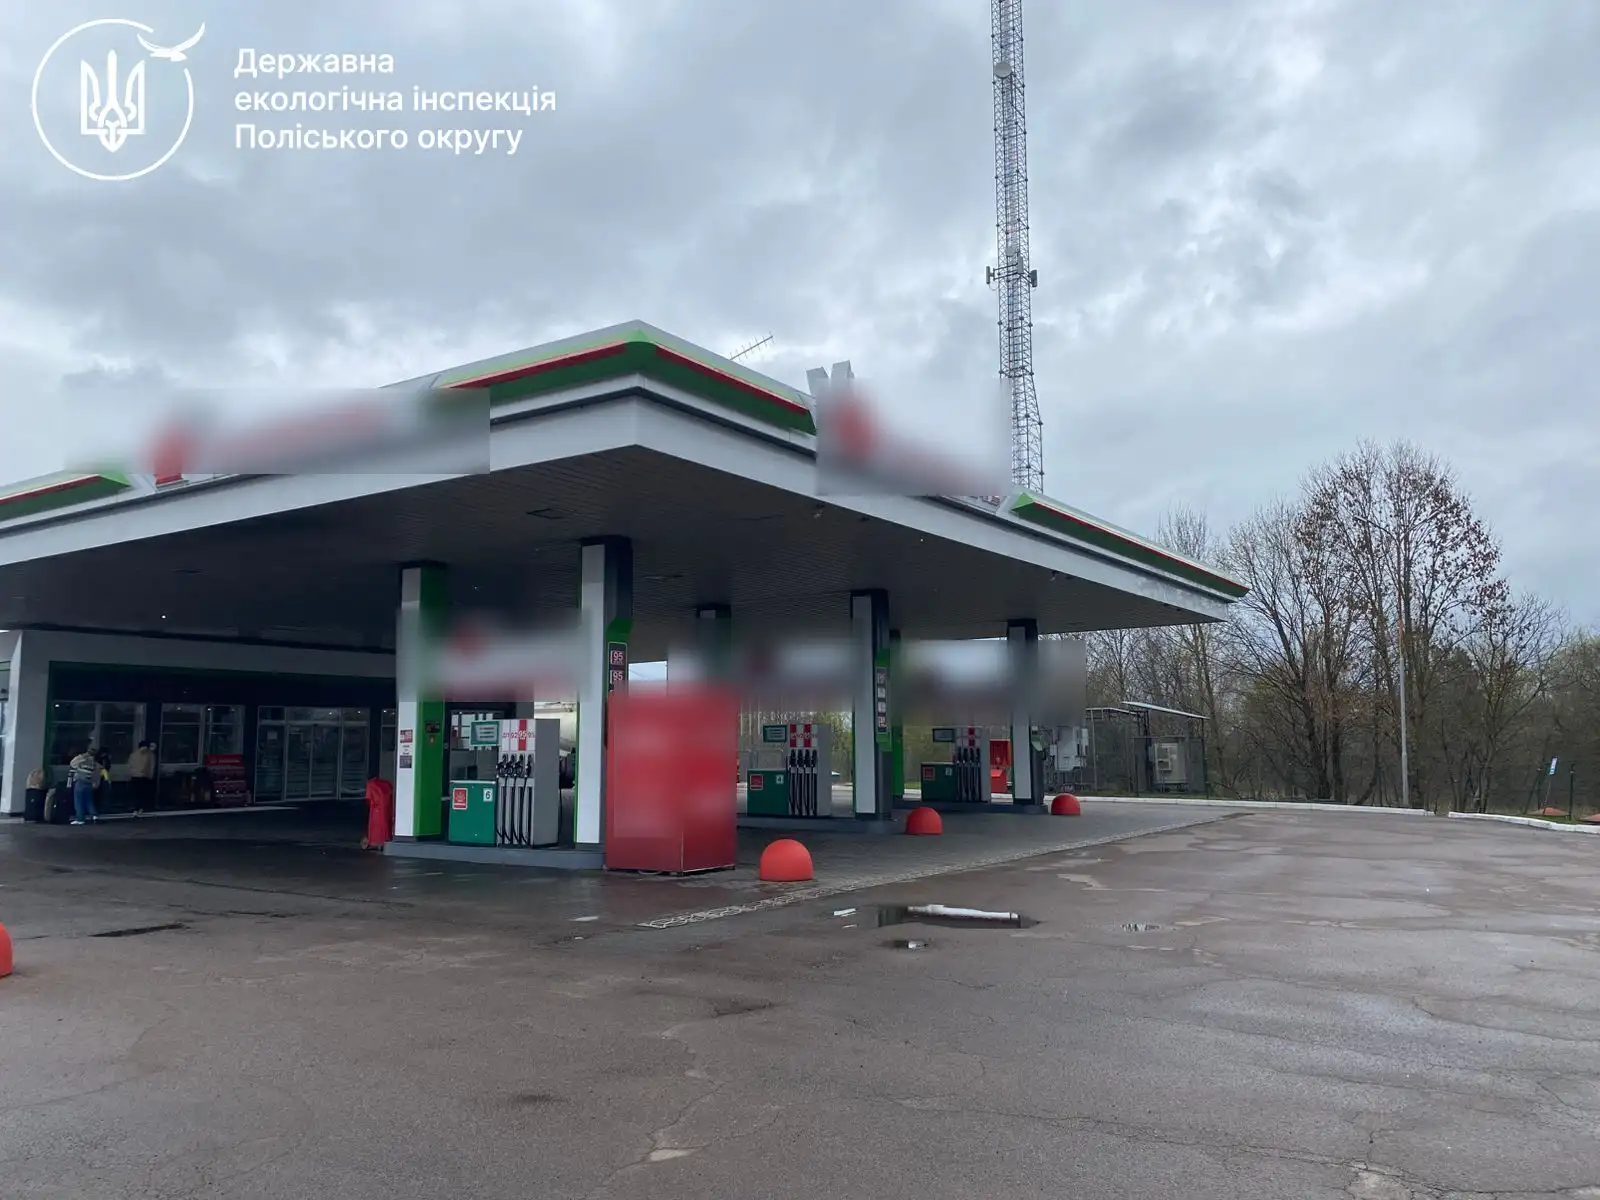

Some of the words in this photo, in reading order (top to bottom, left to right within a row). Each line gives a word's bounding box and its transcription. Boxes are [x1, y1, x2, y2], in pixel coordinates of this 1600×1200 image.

[613, 651, 624, 661] 95
[519, 730, 528, 738] 95
[485, 790, 491, 800] 6
